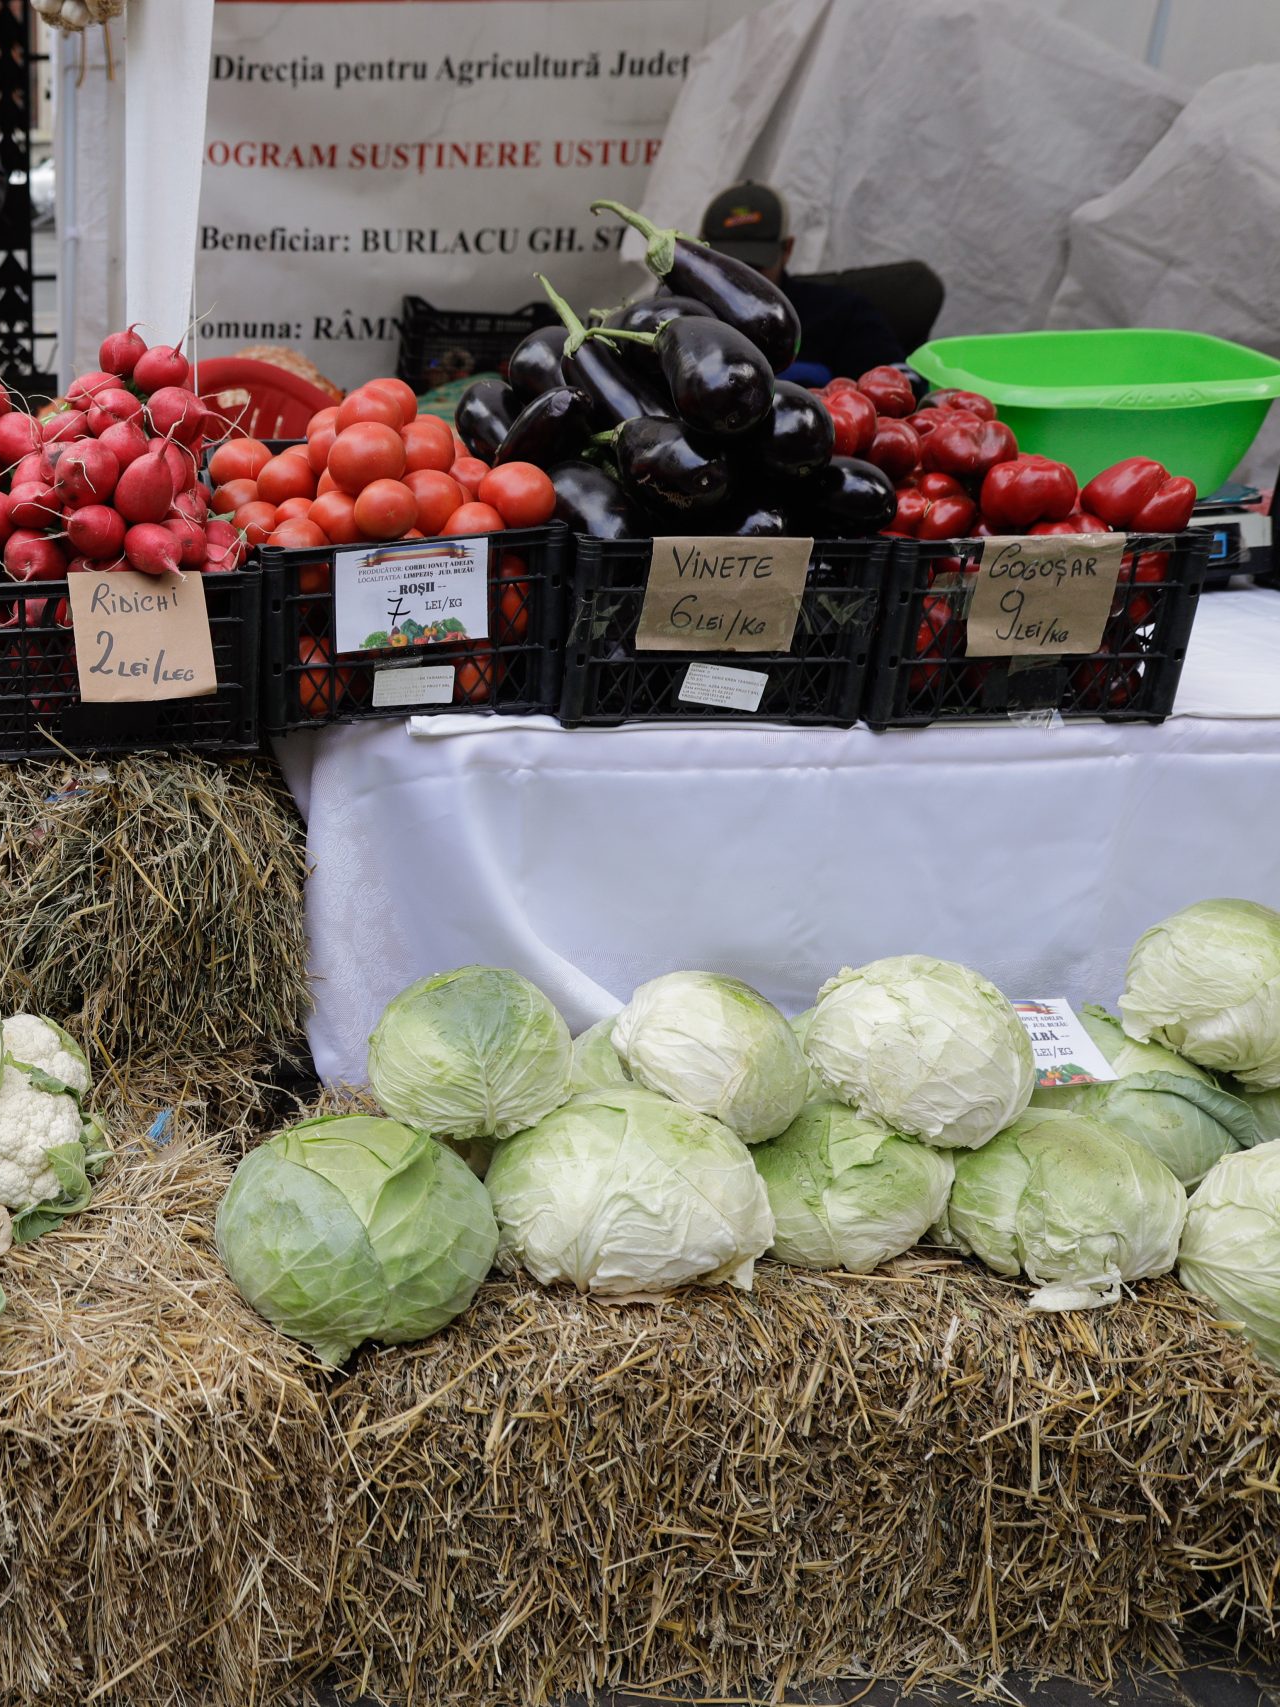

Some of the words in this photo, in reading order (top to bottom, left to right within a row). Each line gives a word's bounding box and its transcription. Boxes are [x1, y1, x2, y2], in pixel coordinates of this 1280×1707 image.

[213, 54, 324, 88] Direcția
[335, 57, 428, 89] pentru
[435, 52, 600, 88] Agricultură
[205, 140, 338, 169] OGRAM
[348, 139, 541, 174] SUSȚINERE
[201, 225, 350, 253] Beneficiar:
[362, 227, 519, 254] BURLACU
[528, 226, 584, 253] GH.
[191, 316, 303, 341] omuna:
[399, 581, 435, 596] ROȘII
[387, 597, 411, 626] 7
[425, 596, 463, 612] LEI/KG
